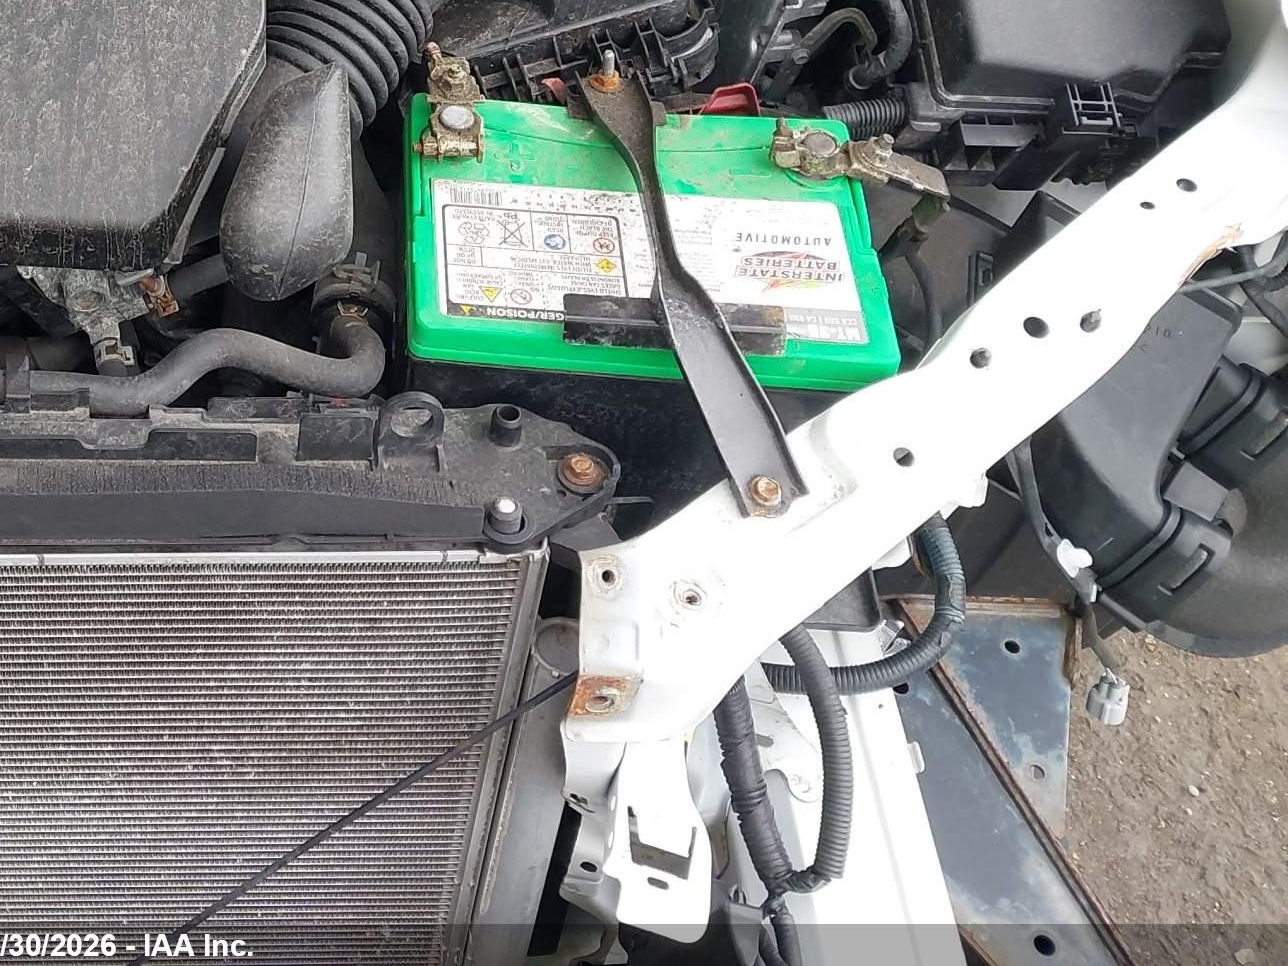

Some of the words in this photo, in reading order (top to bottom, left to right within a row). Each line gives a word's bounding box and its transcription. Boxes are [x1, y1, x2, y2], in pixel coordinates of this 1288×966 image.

[503, 212, 518, 220] Pb
[735, 232, 831, 246] AUTOMOTIVE
[743, 257, 837, 269] BATTERIES
[737, 267, 843, 282] INTERSTATE
[487, 307, 564, 320] GER/POISON
